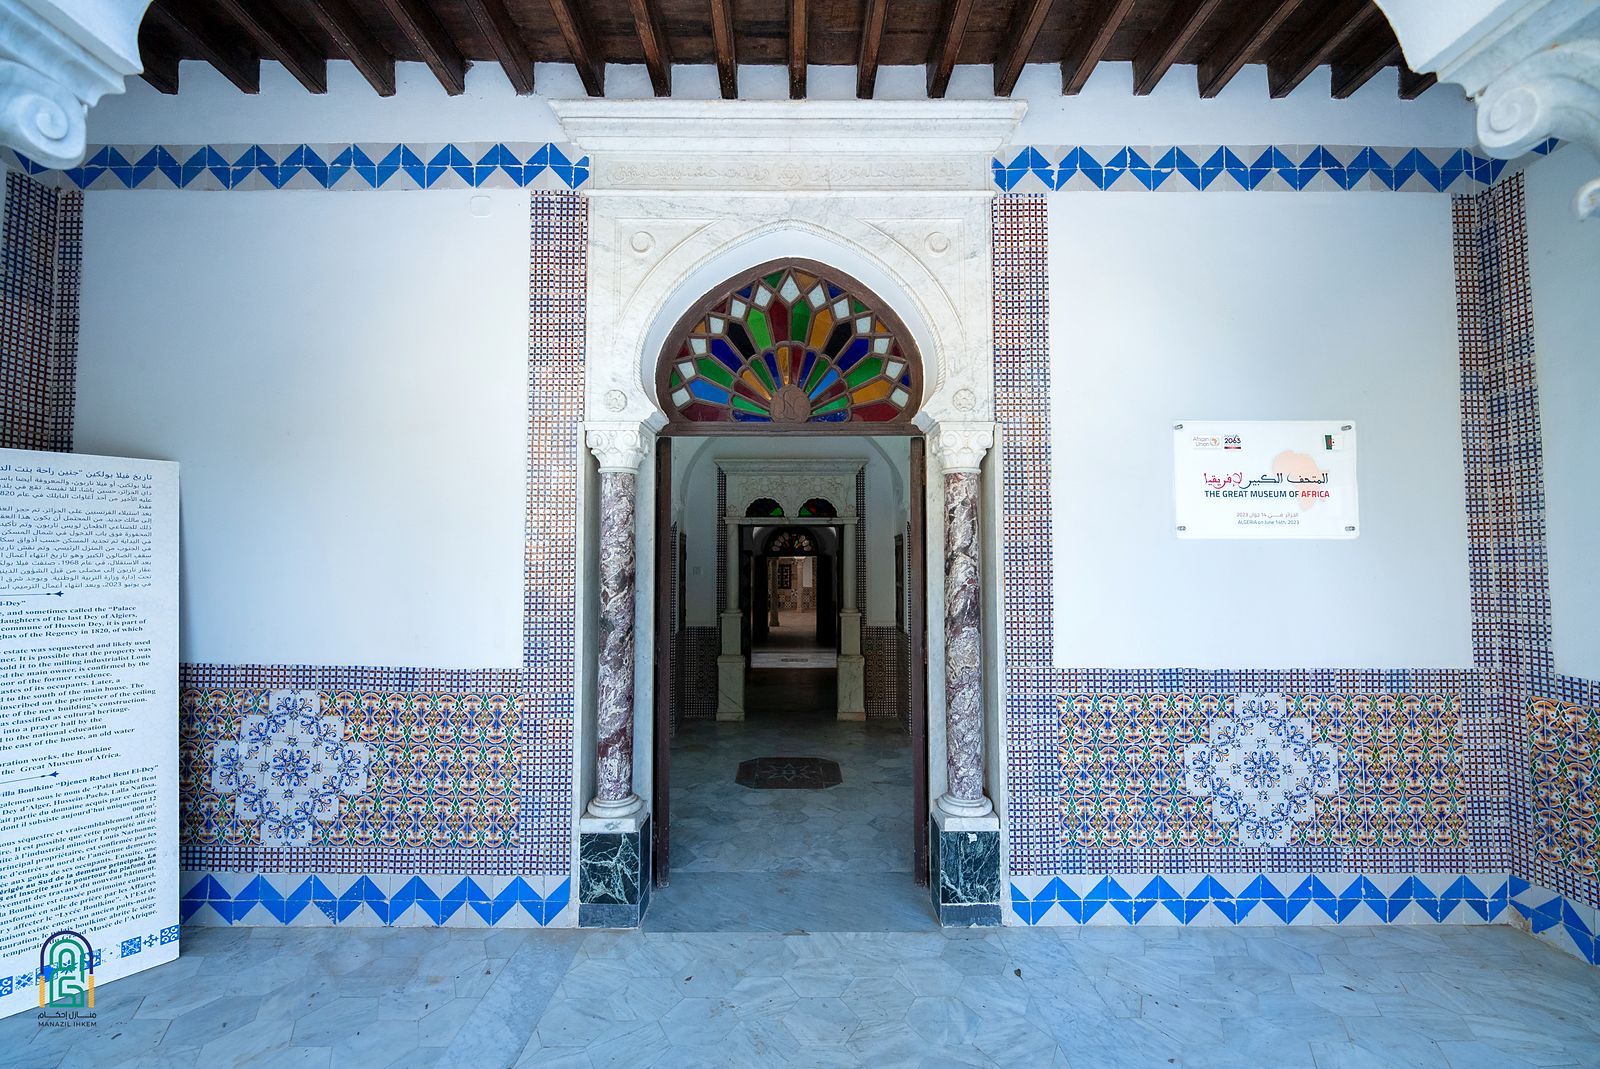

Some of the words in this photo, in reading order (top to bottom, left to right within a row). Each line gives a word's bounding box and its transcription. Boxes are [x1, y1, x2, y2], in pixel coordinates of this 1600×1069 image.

[1224, 436, 1242, 444] 2063
[1238, 473, 1282, 490] الكبير
[1287, 473, 1328, 484] المتحف
[18, 785, 54, 794] Boulkine
